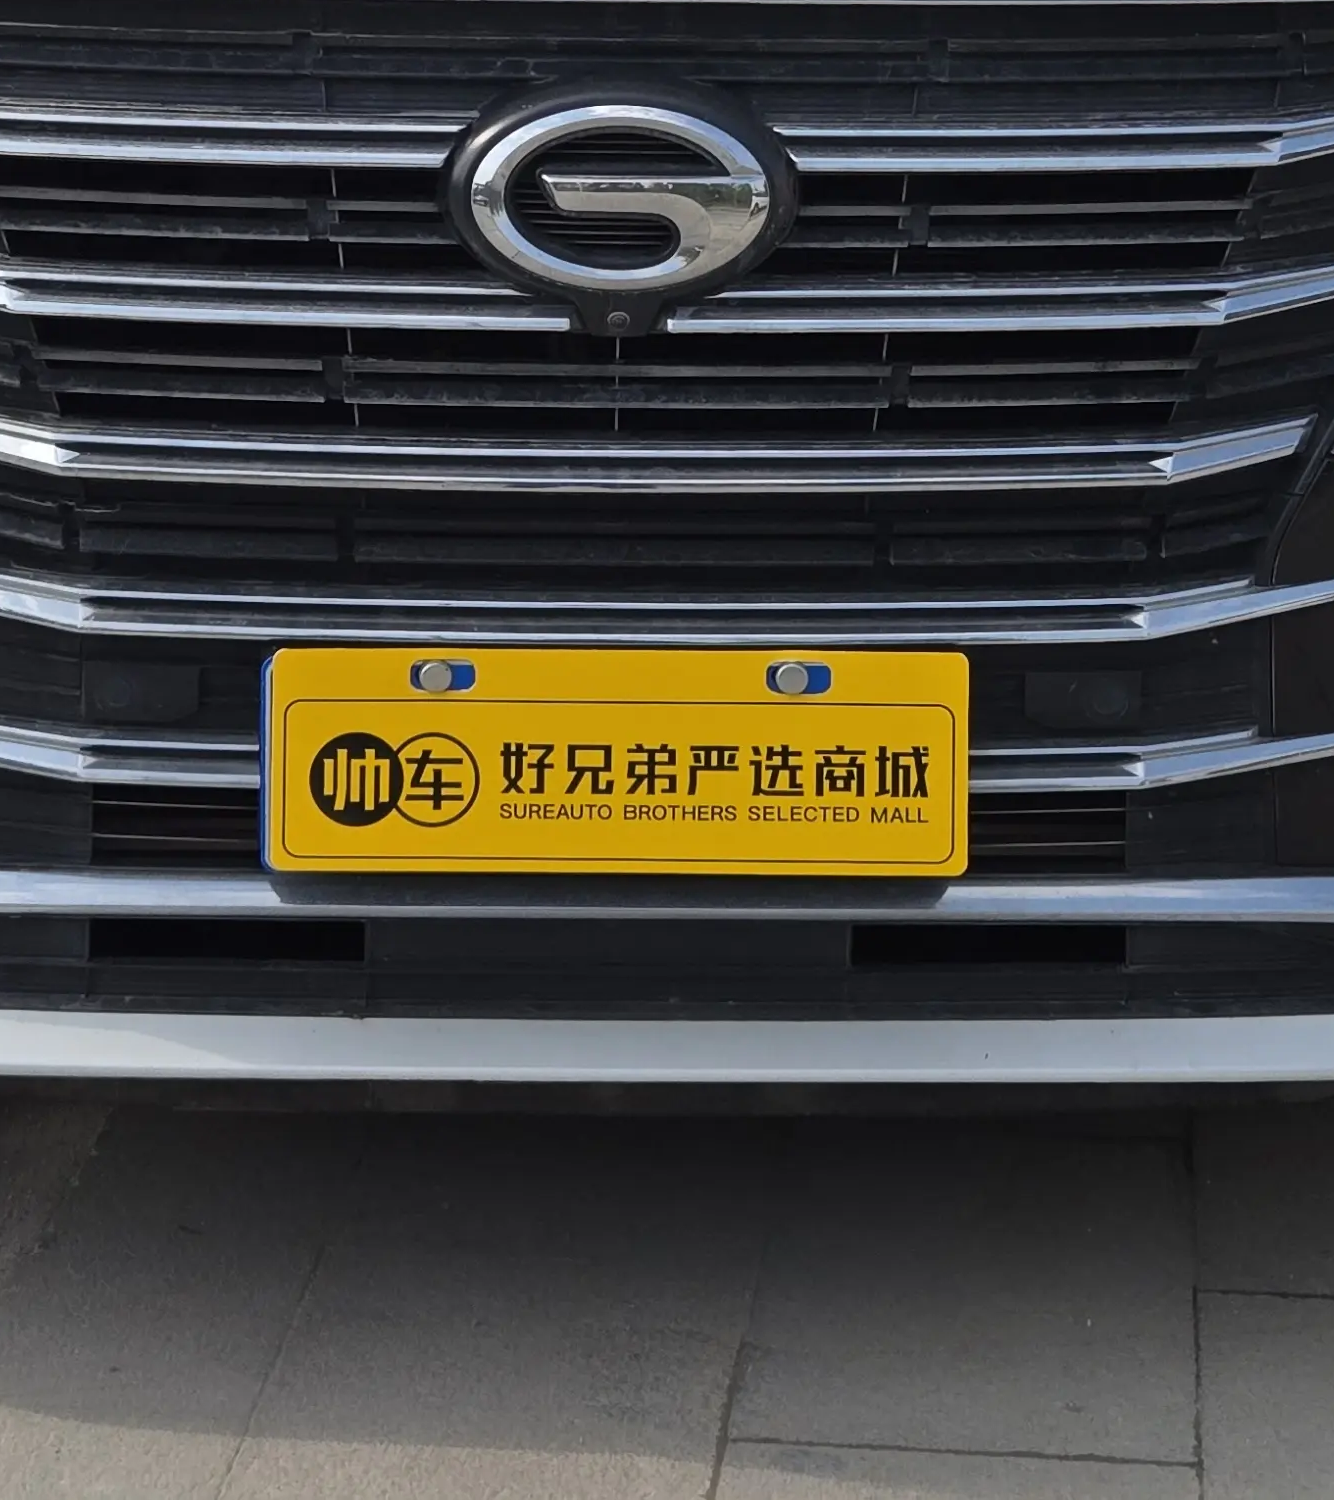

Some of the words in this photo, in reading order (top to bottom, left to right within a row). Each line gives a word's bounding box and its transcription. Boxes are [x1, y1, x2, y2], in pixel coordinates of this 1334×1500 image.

[319, 743, 470, 816] 帅车
[499, 741, 931, 799] 好兄弟严选商城
[499, 803, 613, 821] SUREAUTO
[623, 804, 737, 822] BROTHERS
[747, 805, 860, 823] SELECTED
[870, 807, 929, 824] MALL
